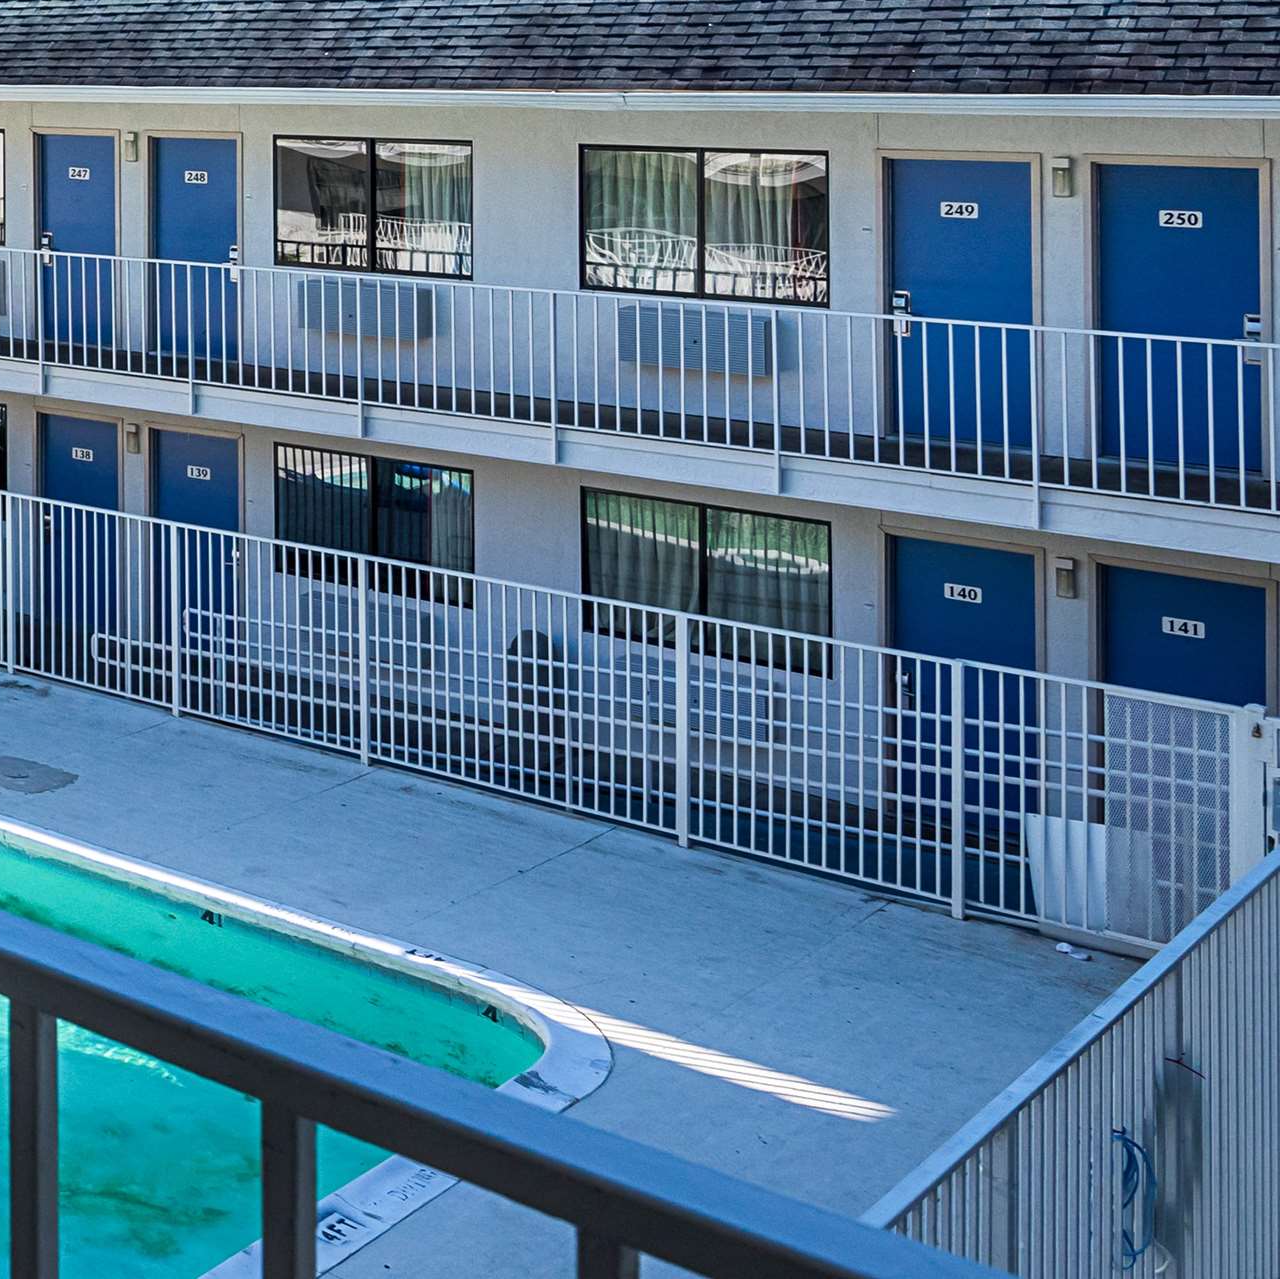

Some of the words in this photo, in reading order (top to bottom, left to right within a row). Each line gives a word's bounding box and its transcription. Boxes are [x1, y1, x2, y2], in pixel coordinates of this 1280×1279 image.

[70, 168, 88, 179] 247
[186, 172, 206, 183] 248
[944, 203, 975, 217] 249
[1162, 212, 1200, 226] 250
[73, 448, 92, 460] 138
[189, 466, 209, 479] 139
[948, 586, 979, 601] 140
[1167, 619, 1200, 636] 141
[320, 1217, 359, 1242] 4FT
